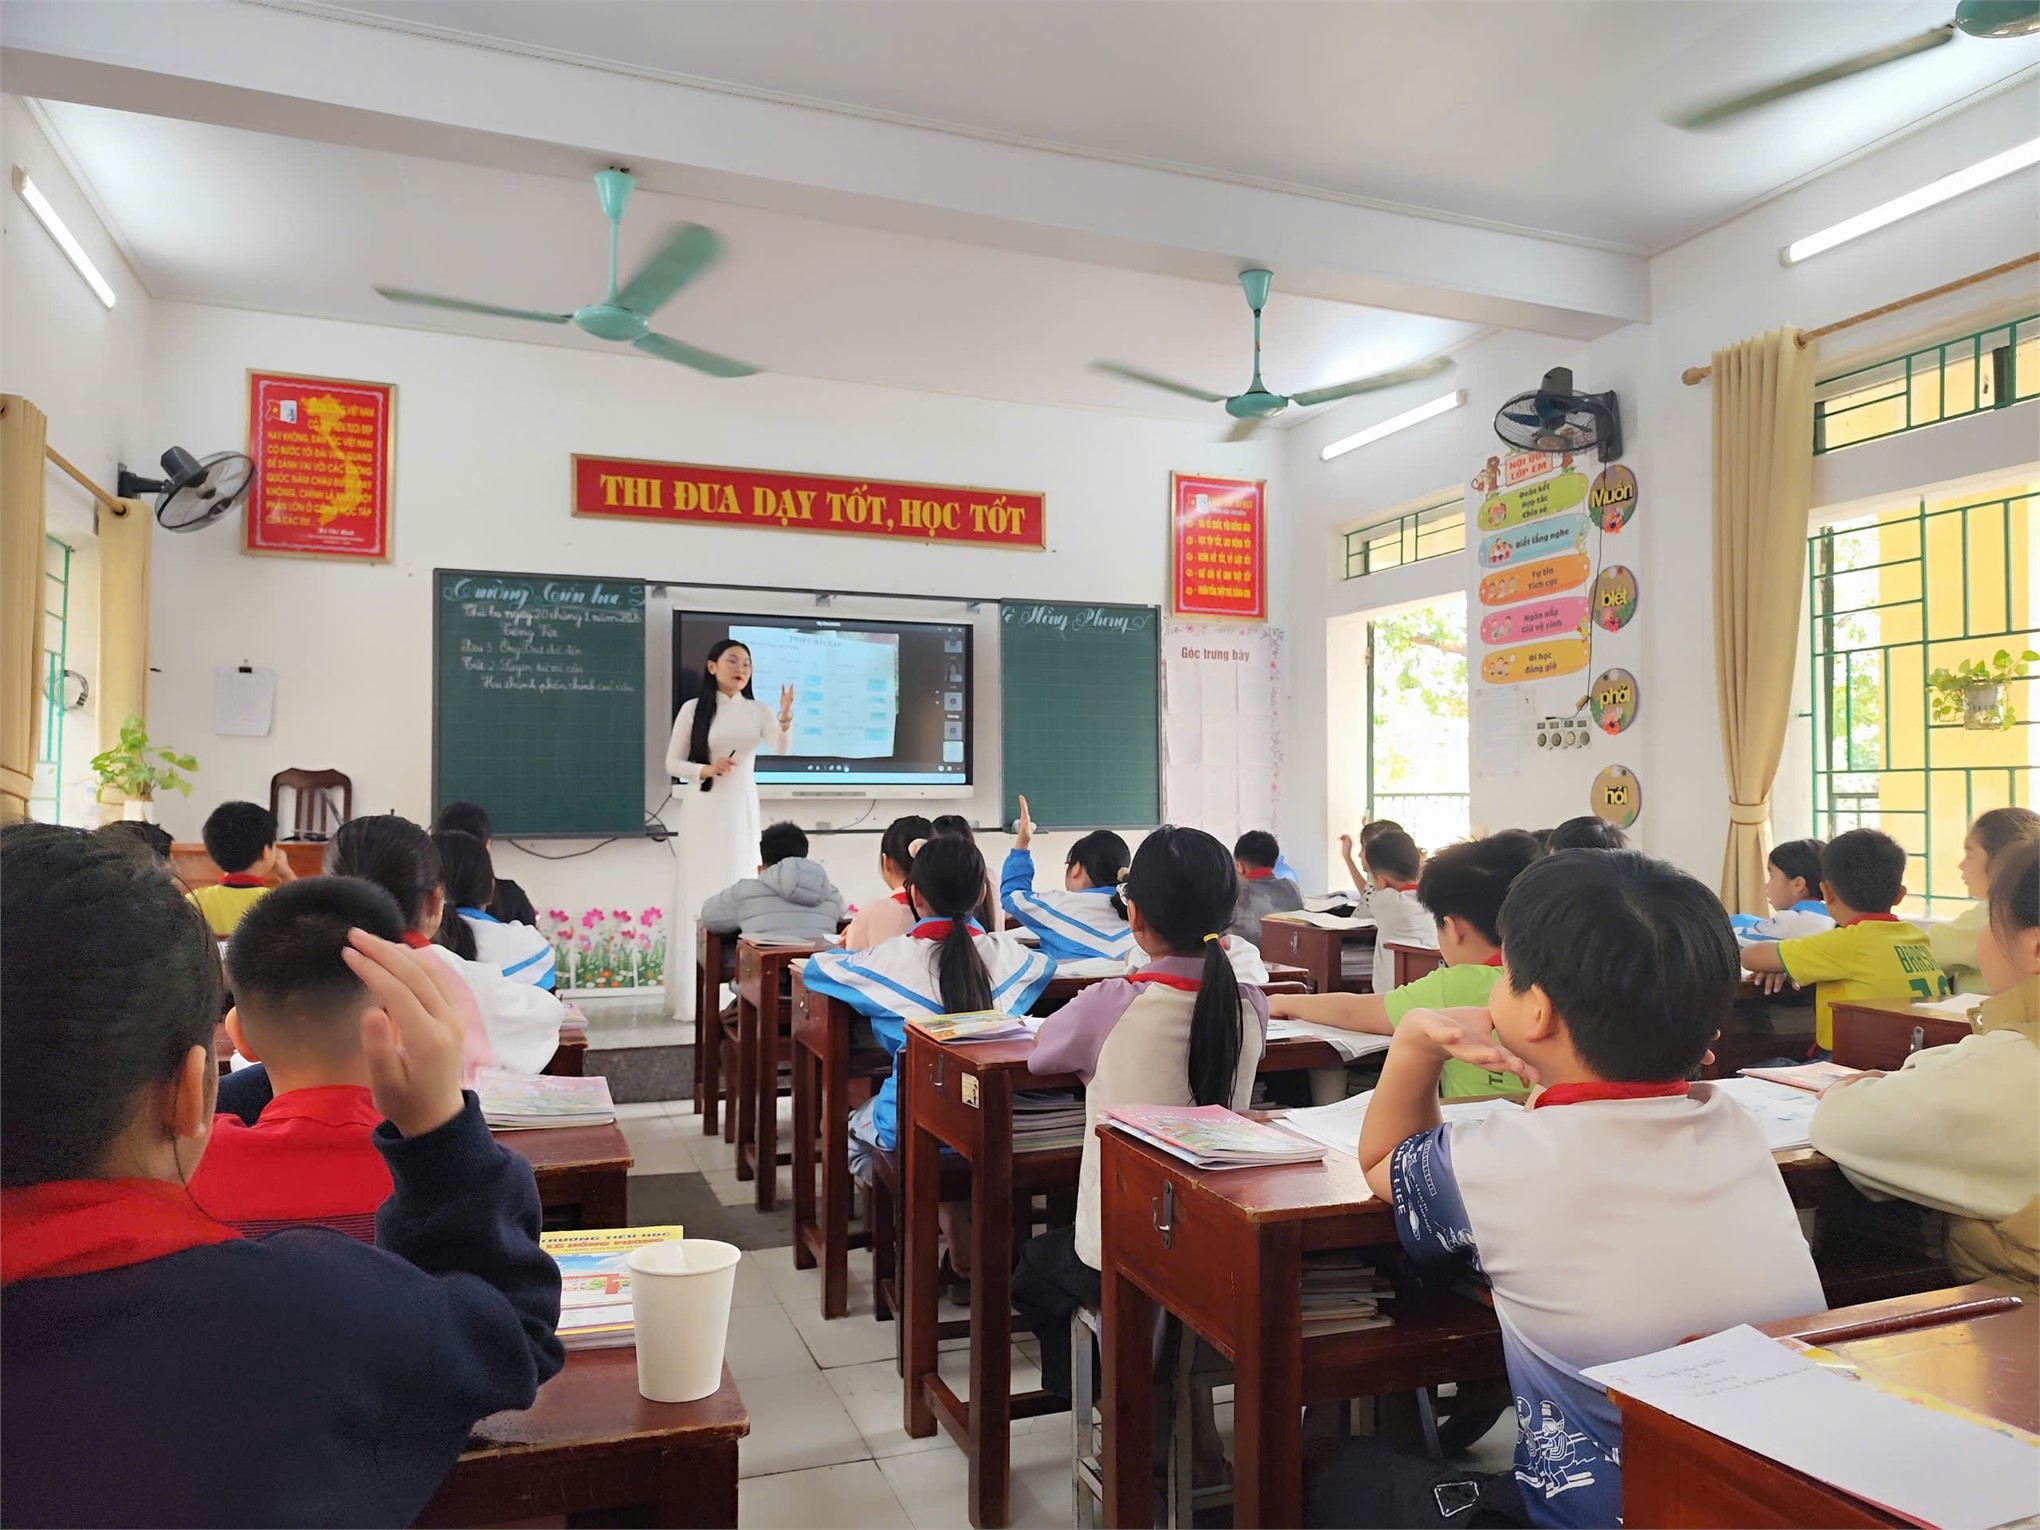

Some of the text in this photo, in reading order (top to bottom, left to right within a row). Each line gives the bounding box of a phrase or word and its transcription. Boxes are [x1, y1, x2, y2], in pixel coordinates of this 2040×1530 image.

[1509, 457, 1526, 470] NỘI
[1511, 461, 1547, 480] LỚP EM
[600, 473, 1026, 537] THI ĐUA DẠY TỐT, HỌC TỐT
[1522, 508, 1538, 519] Chia
[1515, 535, 1531, 549] Biết
[1550, 528, 1570, 543] nghe
[1528, 580, 1544, 590] Tích
[1601, 585, 1629, 608] biết
[1545, 619, 1562, 630] sinh
[1181, 646, 1250, 663] Góc trưng bày
[1538, 652, 1552, 664] học
[1393, 1178, 1407, 1215] LIFE
